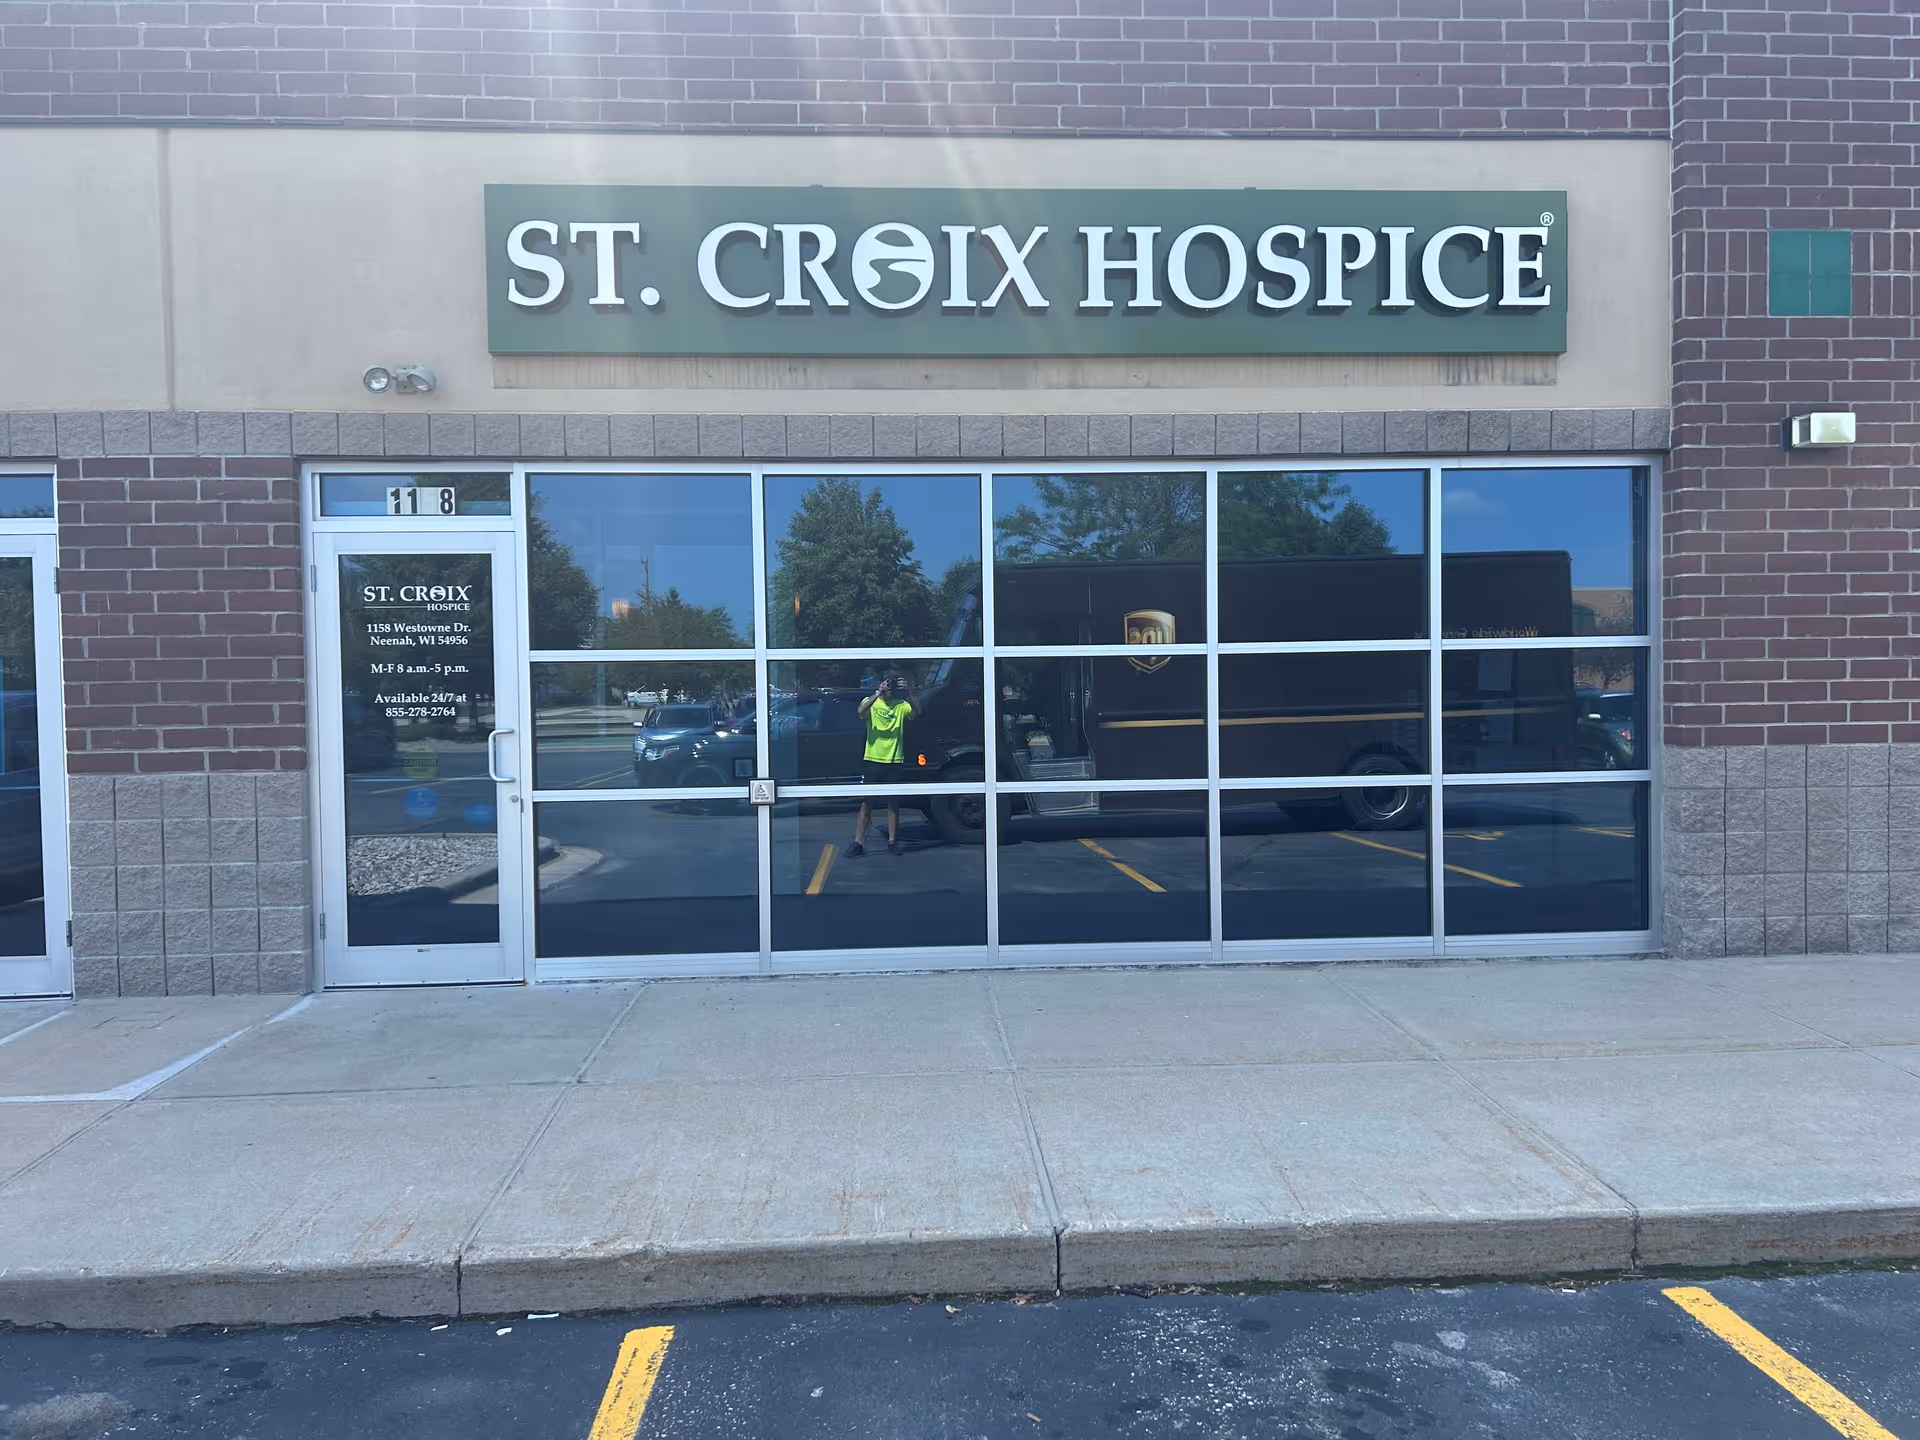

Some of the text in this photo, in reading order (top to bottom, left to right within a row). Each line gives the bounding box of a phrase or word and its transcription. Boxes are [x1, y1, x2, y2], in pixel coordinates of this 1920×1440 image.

[506, 219, 661, 308] ST.
[696, 221, 1051, 311] CROIX
[363, 585, 395, 602] ST.
[427, 603, 470, 611] HOSPICE
[366, 622, 472, 633] 1158 Westowne Dr.
[370, 636, 468, 647] Neenah, WI 54956
[370, 664, 469, 675] M-F 8 a.m.-5 p.m.
[374, 693, 467, 704] Available 24/7 at
[385, 707, 456, 718] 855-278-2764
